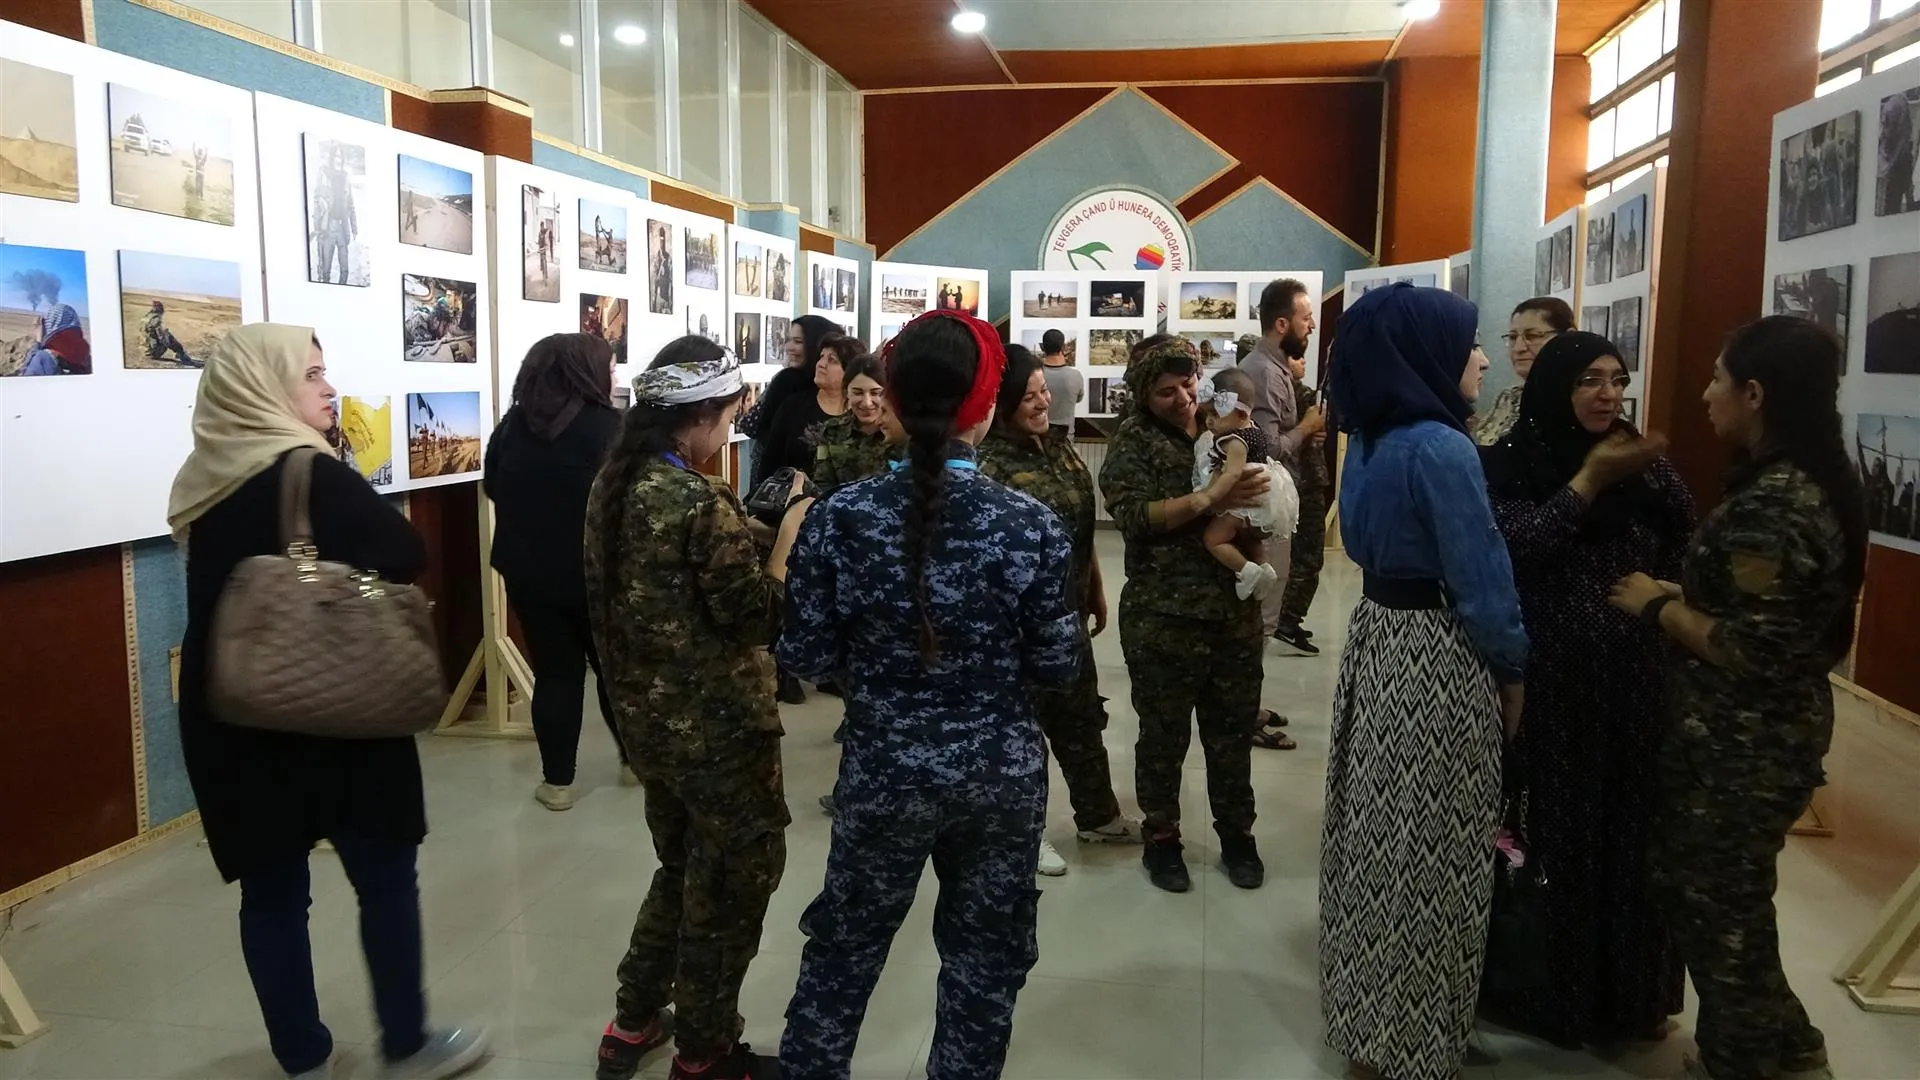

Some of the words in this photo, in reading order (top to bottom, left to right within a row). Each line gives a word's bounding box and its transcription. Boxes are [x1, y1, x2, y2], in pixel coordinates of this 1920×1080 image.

[1053, 215, 1083, 252] TEVGERA
[1082, 202, 1107, 220] ÇAND
[1118, 200, 1153, 221] HUNERA
